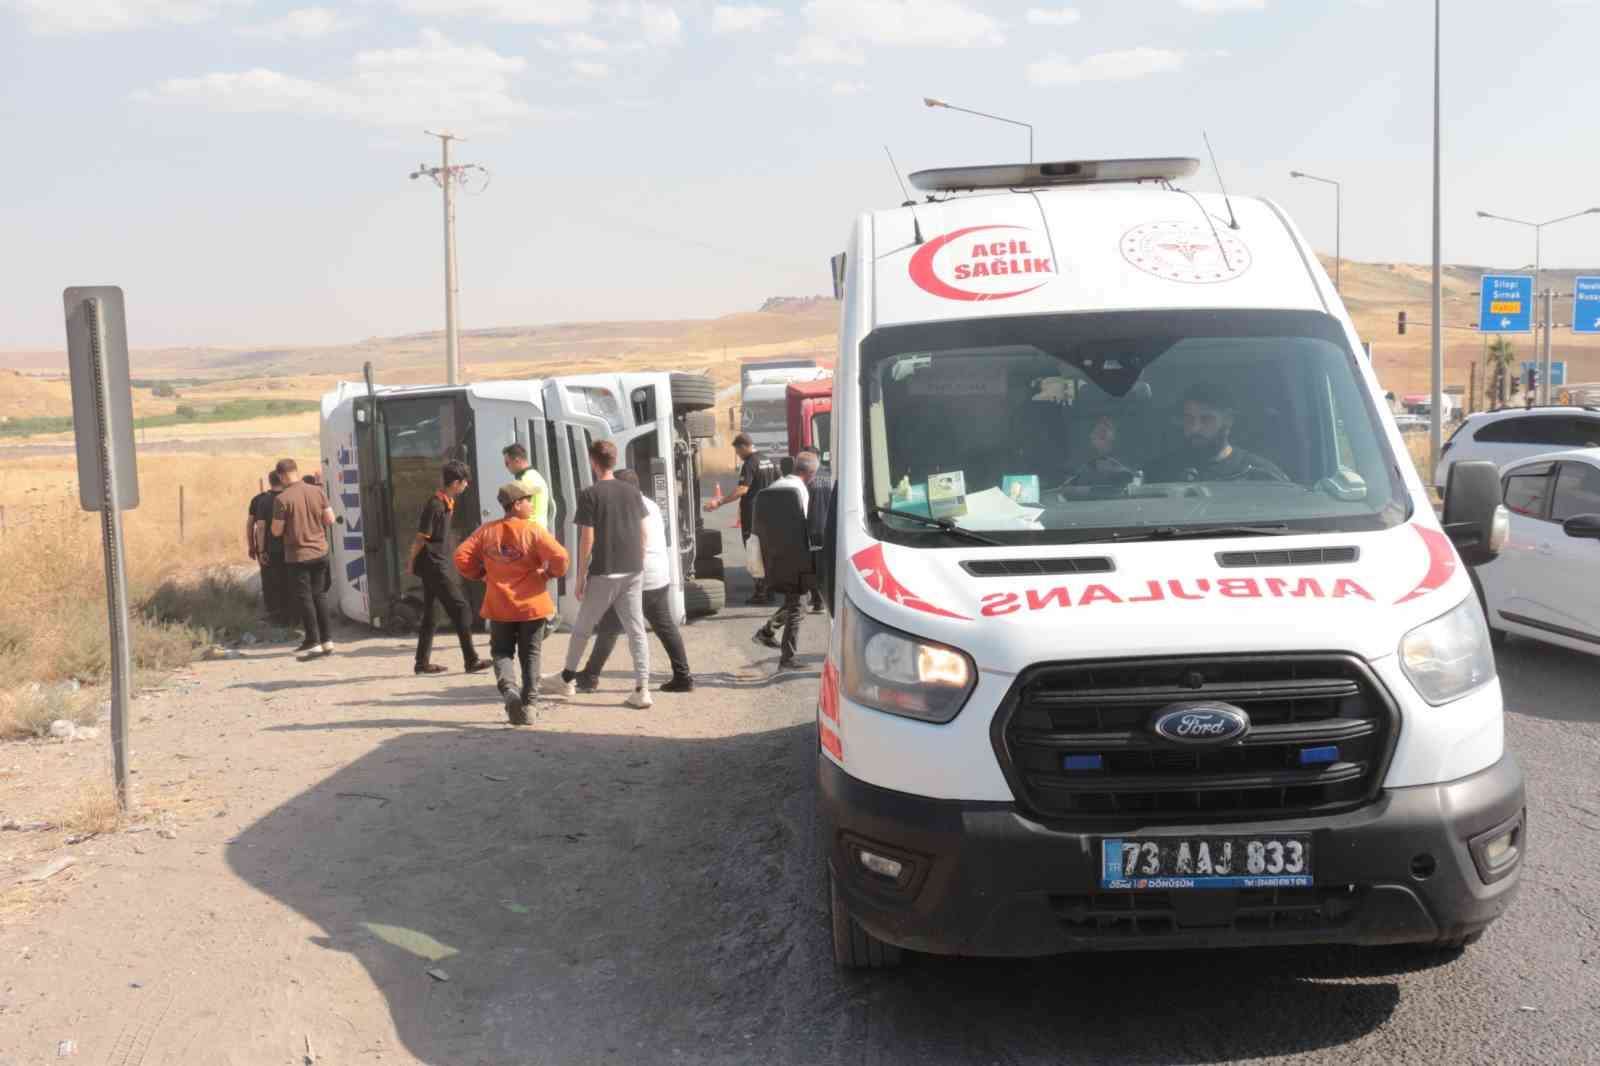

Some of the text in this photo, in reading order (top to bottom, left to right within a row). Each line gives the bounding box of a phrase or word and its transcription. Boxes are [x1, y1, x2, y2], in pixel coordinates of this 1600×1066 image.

[972, 239, 1032, 257] ACİL
[955, 257, 1052, 279] SAĞLIK
[1177, 714, 1225, 735] Ford
[1122, 840, 1304, 875] 73 AAJ 833
